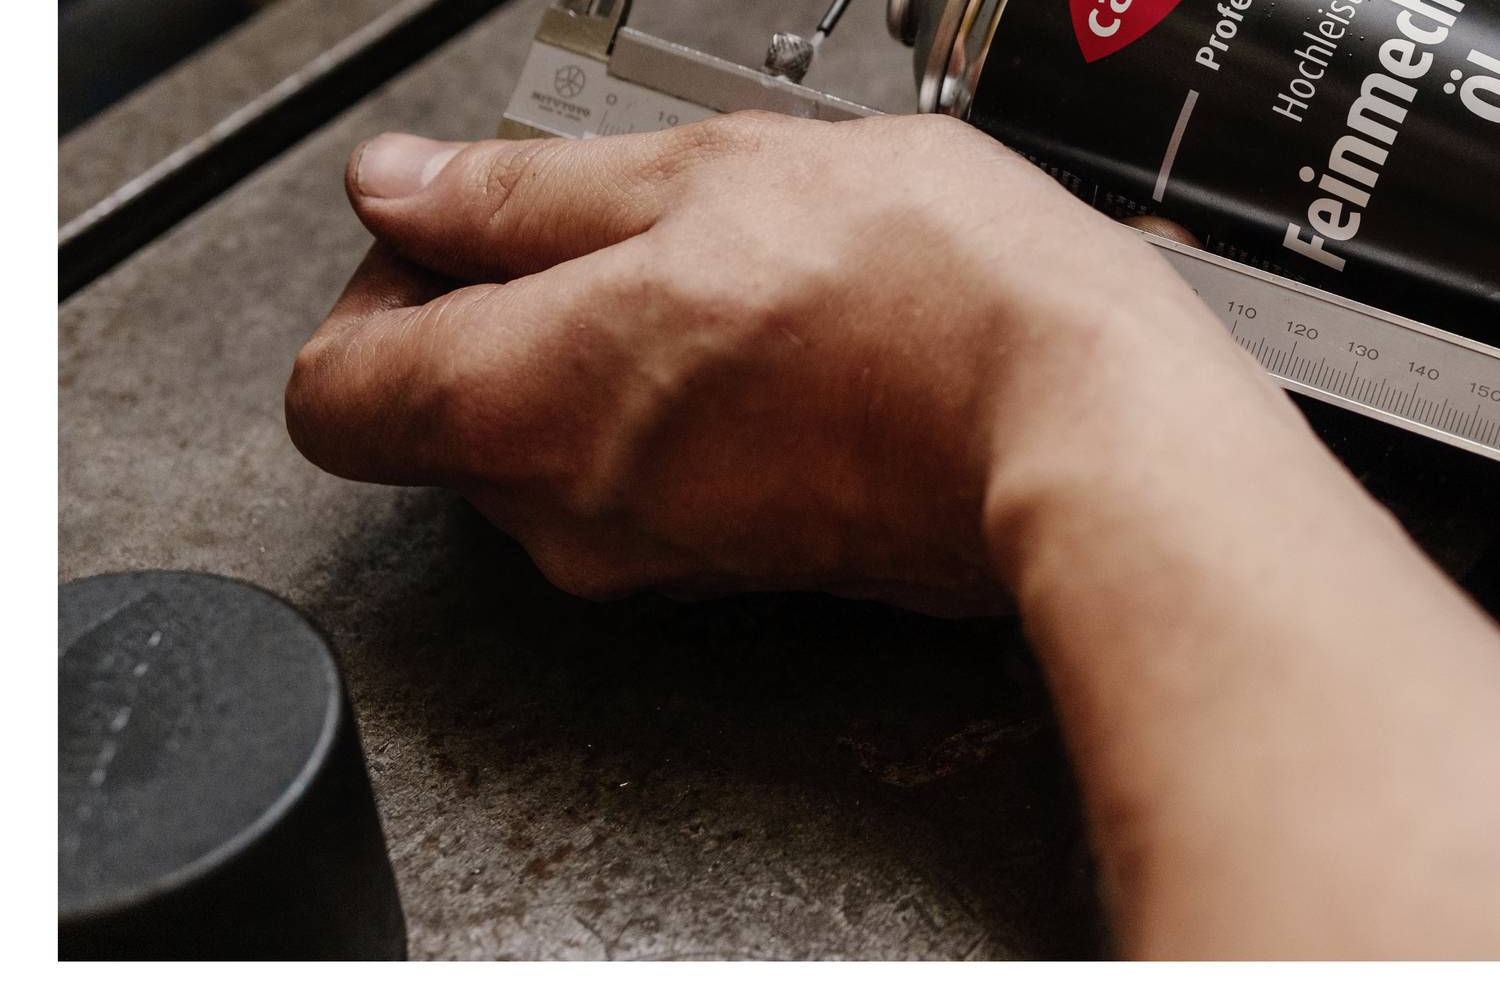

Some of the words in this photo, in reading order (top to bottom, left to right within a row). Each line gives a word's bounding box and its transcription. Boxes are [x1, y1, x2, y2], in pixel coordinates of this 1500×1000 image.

[606, 93, 618, 105] 0
[658, 110, 679, 126] 10
[1226, 301, 1257, 320] 110
[1285, 321, 1319, 340] 120
[1348, 341, 1379, 361] 130
[1407, 361, 1440, 381] 140
